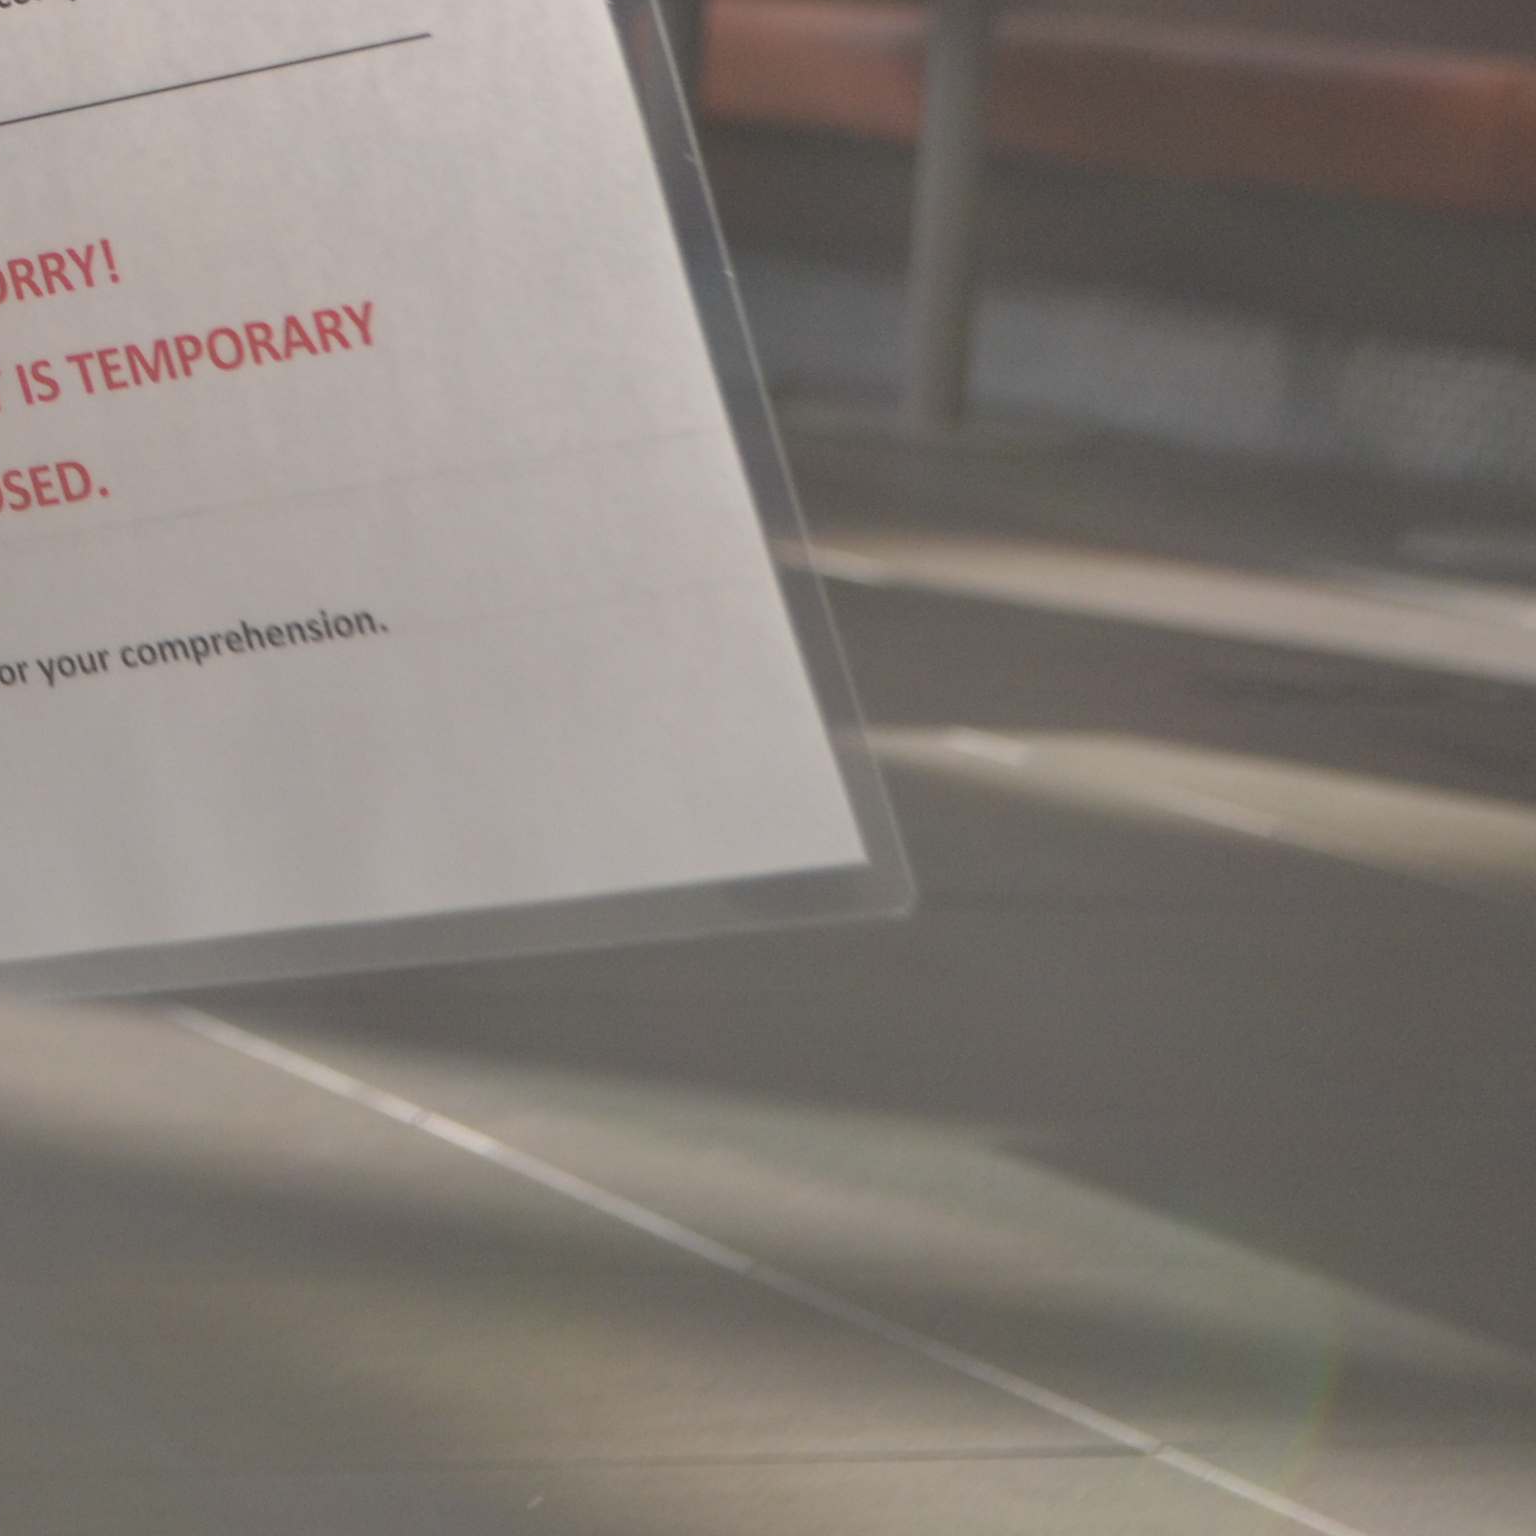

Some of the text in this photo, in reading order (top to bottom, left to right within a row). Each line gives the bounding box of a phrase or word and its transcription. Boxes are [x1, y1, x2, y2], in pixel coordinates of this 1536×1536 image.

[14, 359, 61, 406] IS
[64, 300, 374, 395] TEMPORARY
[35, 649, 110, 688] your
[119, 609, 389, 669] comprehension.
